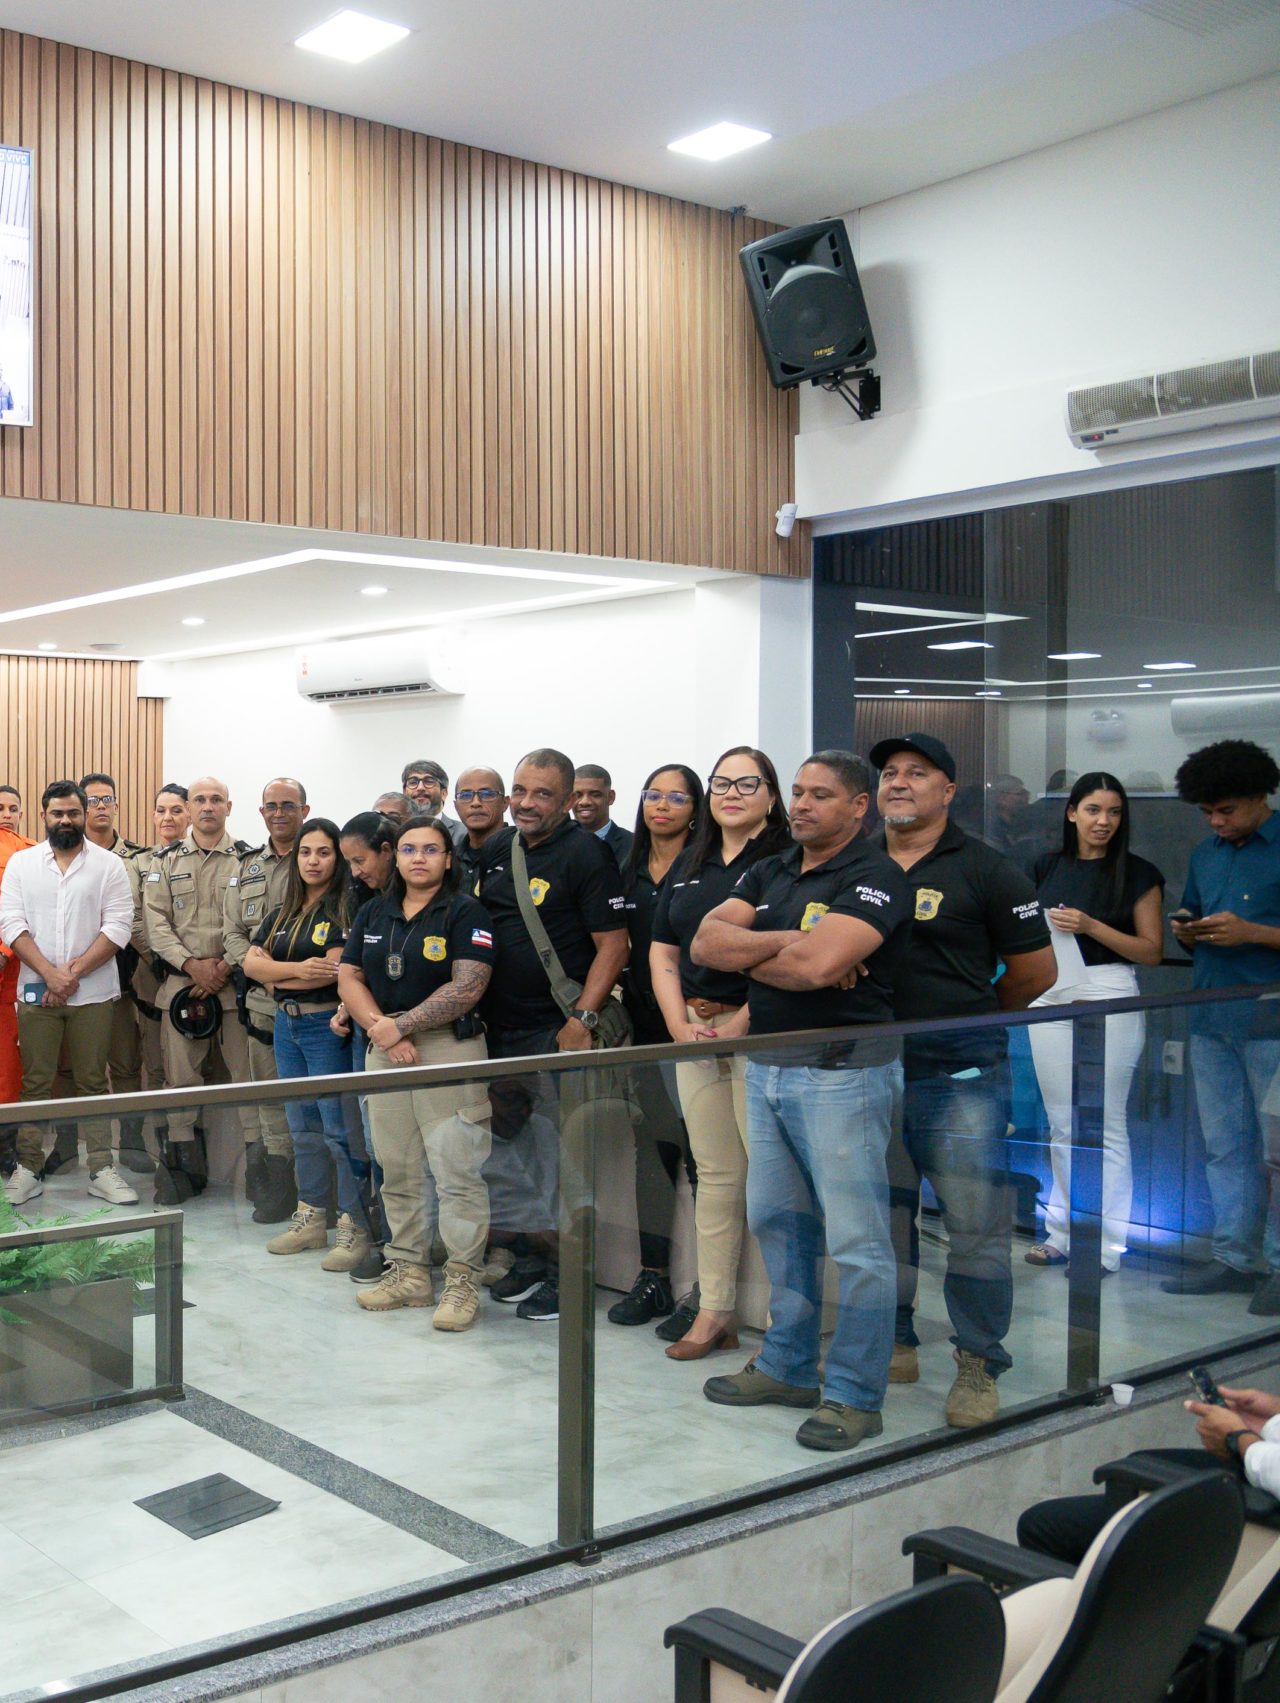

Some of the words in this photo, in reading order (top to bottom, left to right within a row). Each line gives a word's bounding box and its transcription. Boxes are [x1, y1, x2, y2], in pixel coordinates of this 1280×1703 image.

[6, 153, 27, 164] VIVO
[855, 886, 890, 903] POLICIA
[860, 893, 883, 907] CIVIL
[1019, 908, 1039, 920] CIVIL
